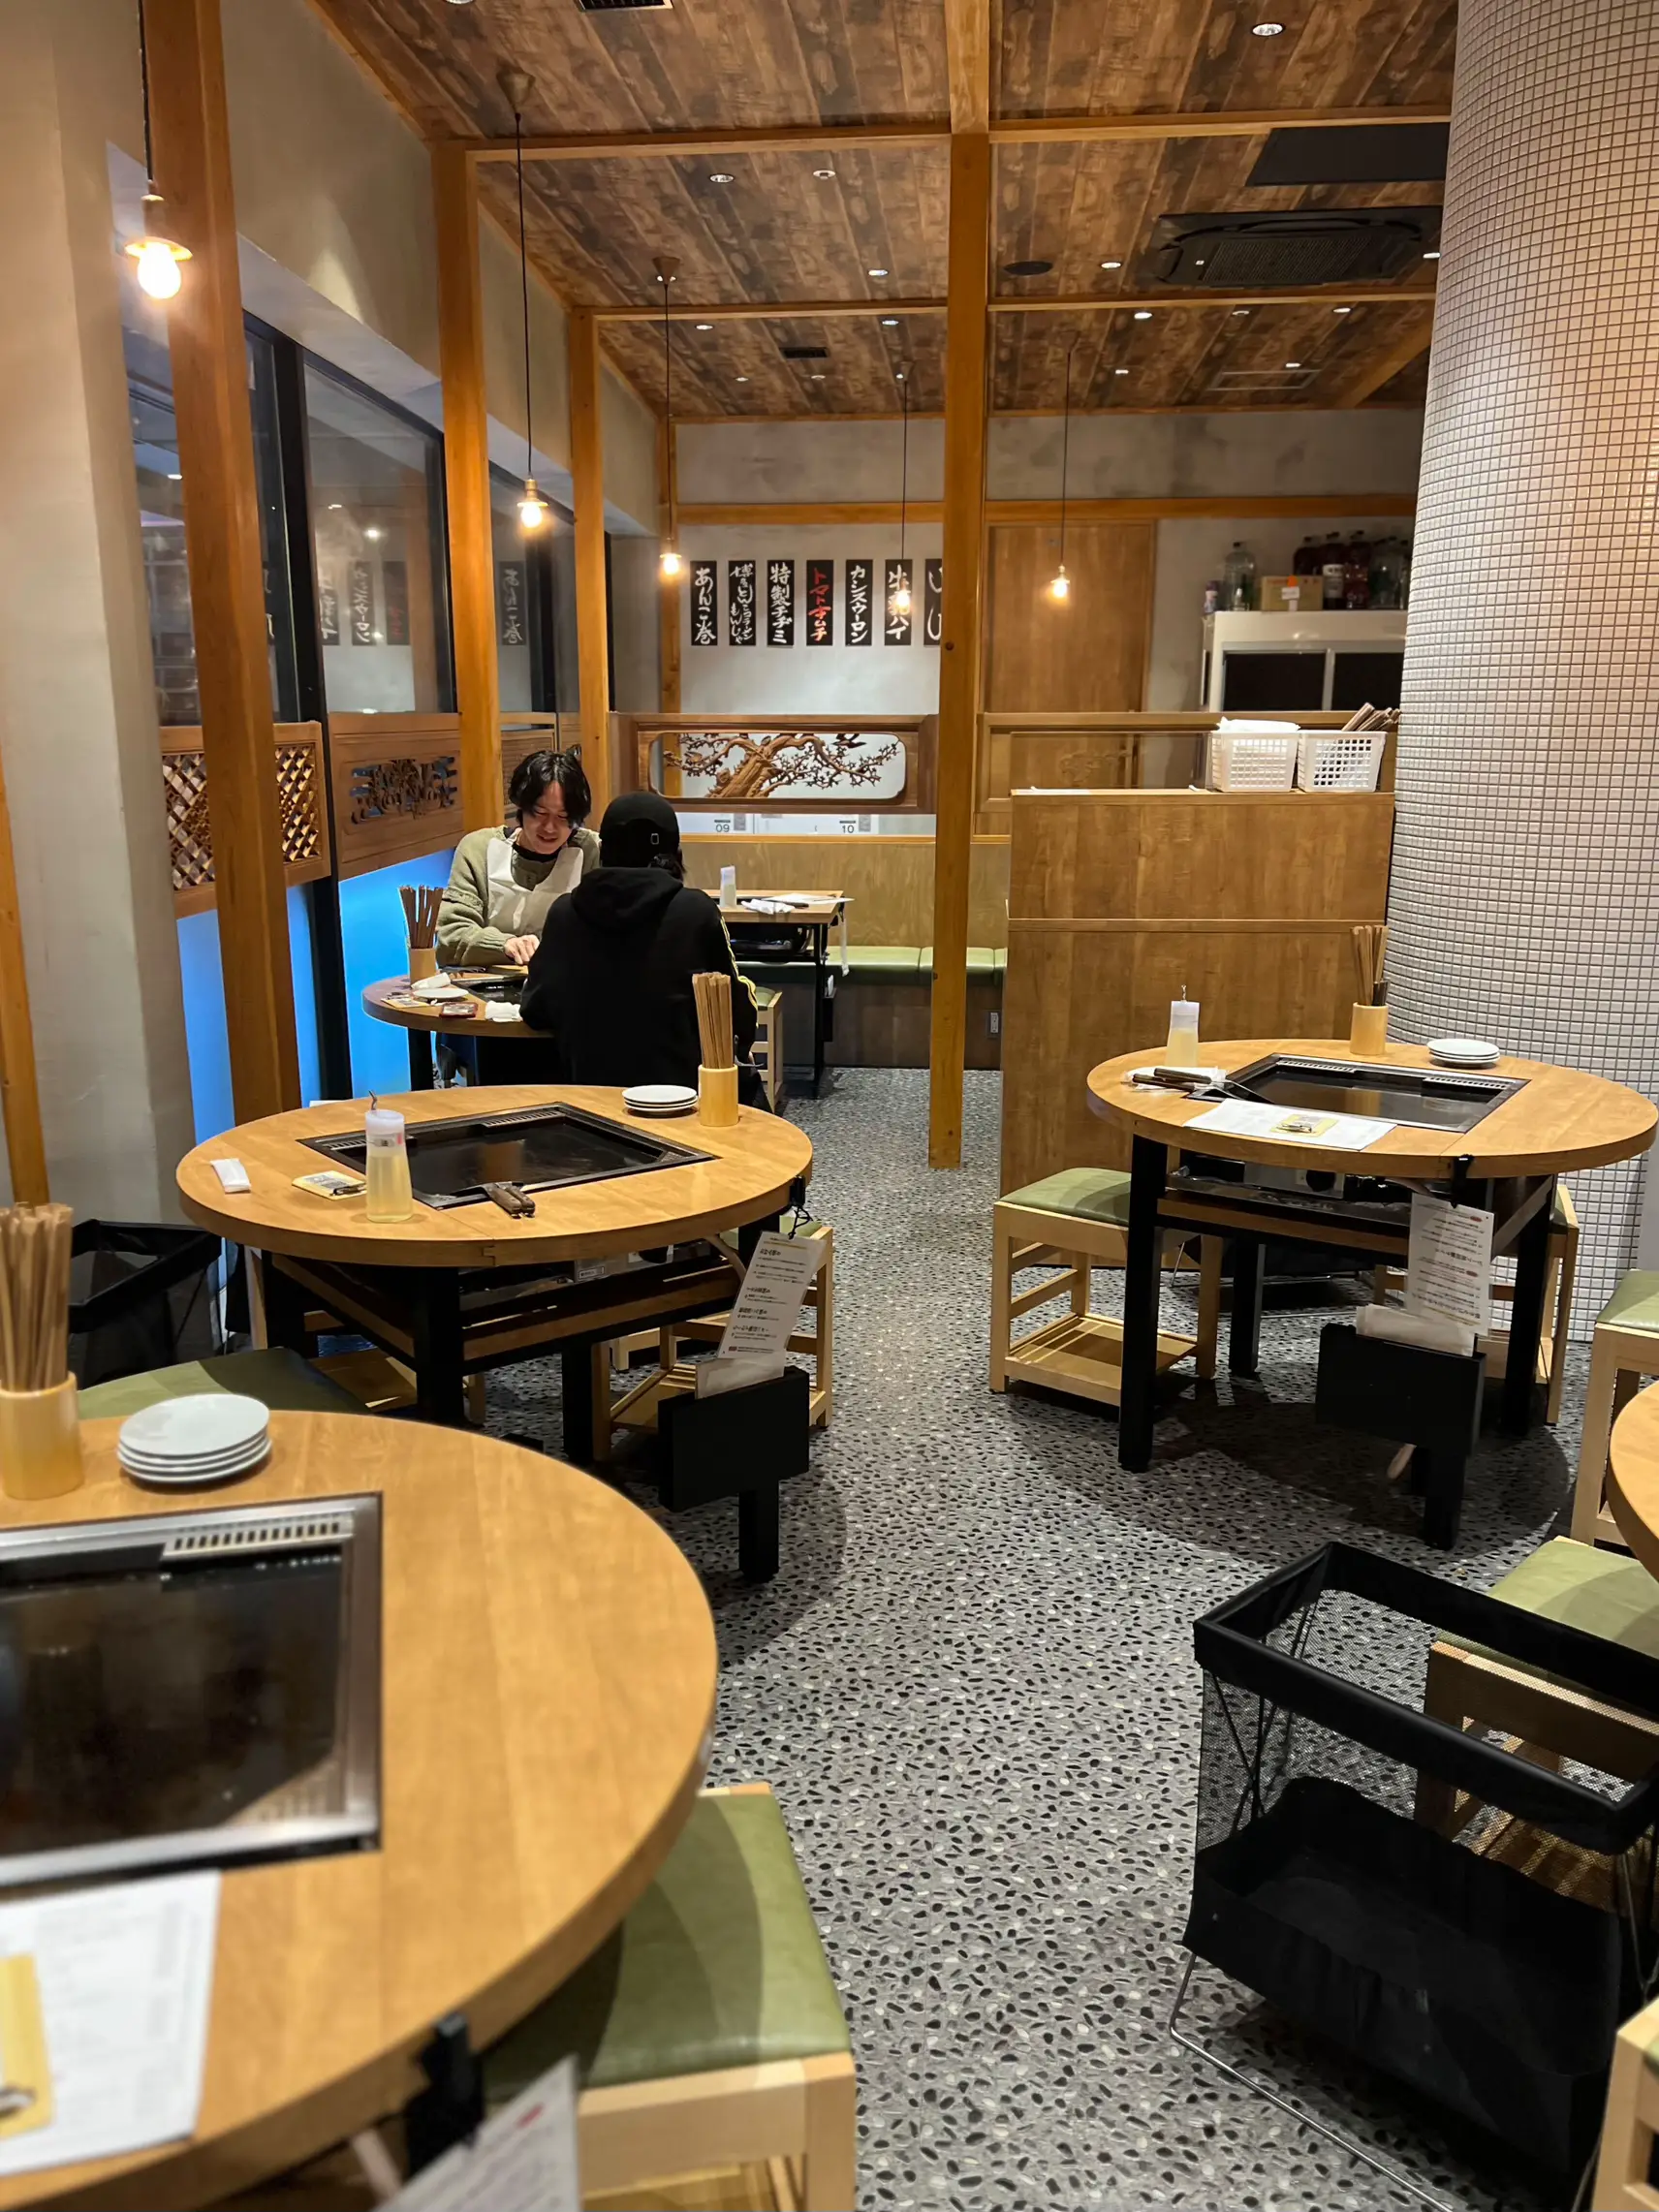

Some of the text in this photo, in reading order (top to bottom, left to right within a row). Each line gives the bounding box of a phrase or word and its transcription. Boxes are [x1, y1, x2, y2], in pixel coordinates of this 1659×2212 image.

[694, 567, 716, 645] あんこ巻
[769, 562, 793, 644] 特製チヂミ
[807, 567, 832, 642] トマトキムチ
[850, 564, 869, 643] カシスウーロン
[715, 824, 730, 833] 09
[841, 825, 855, 834] 10
